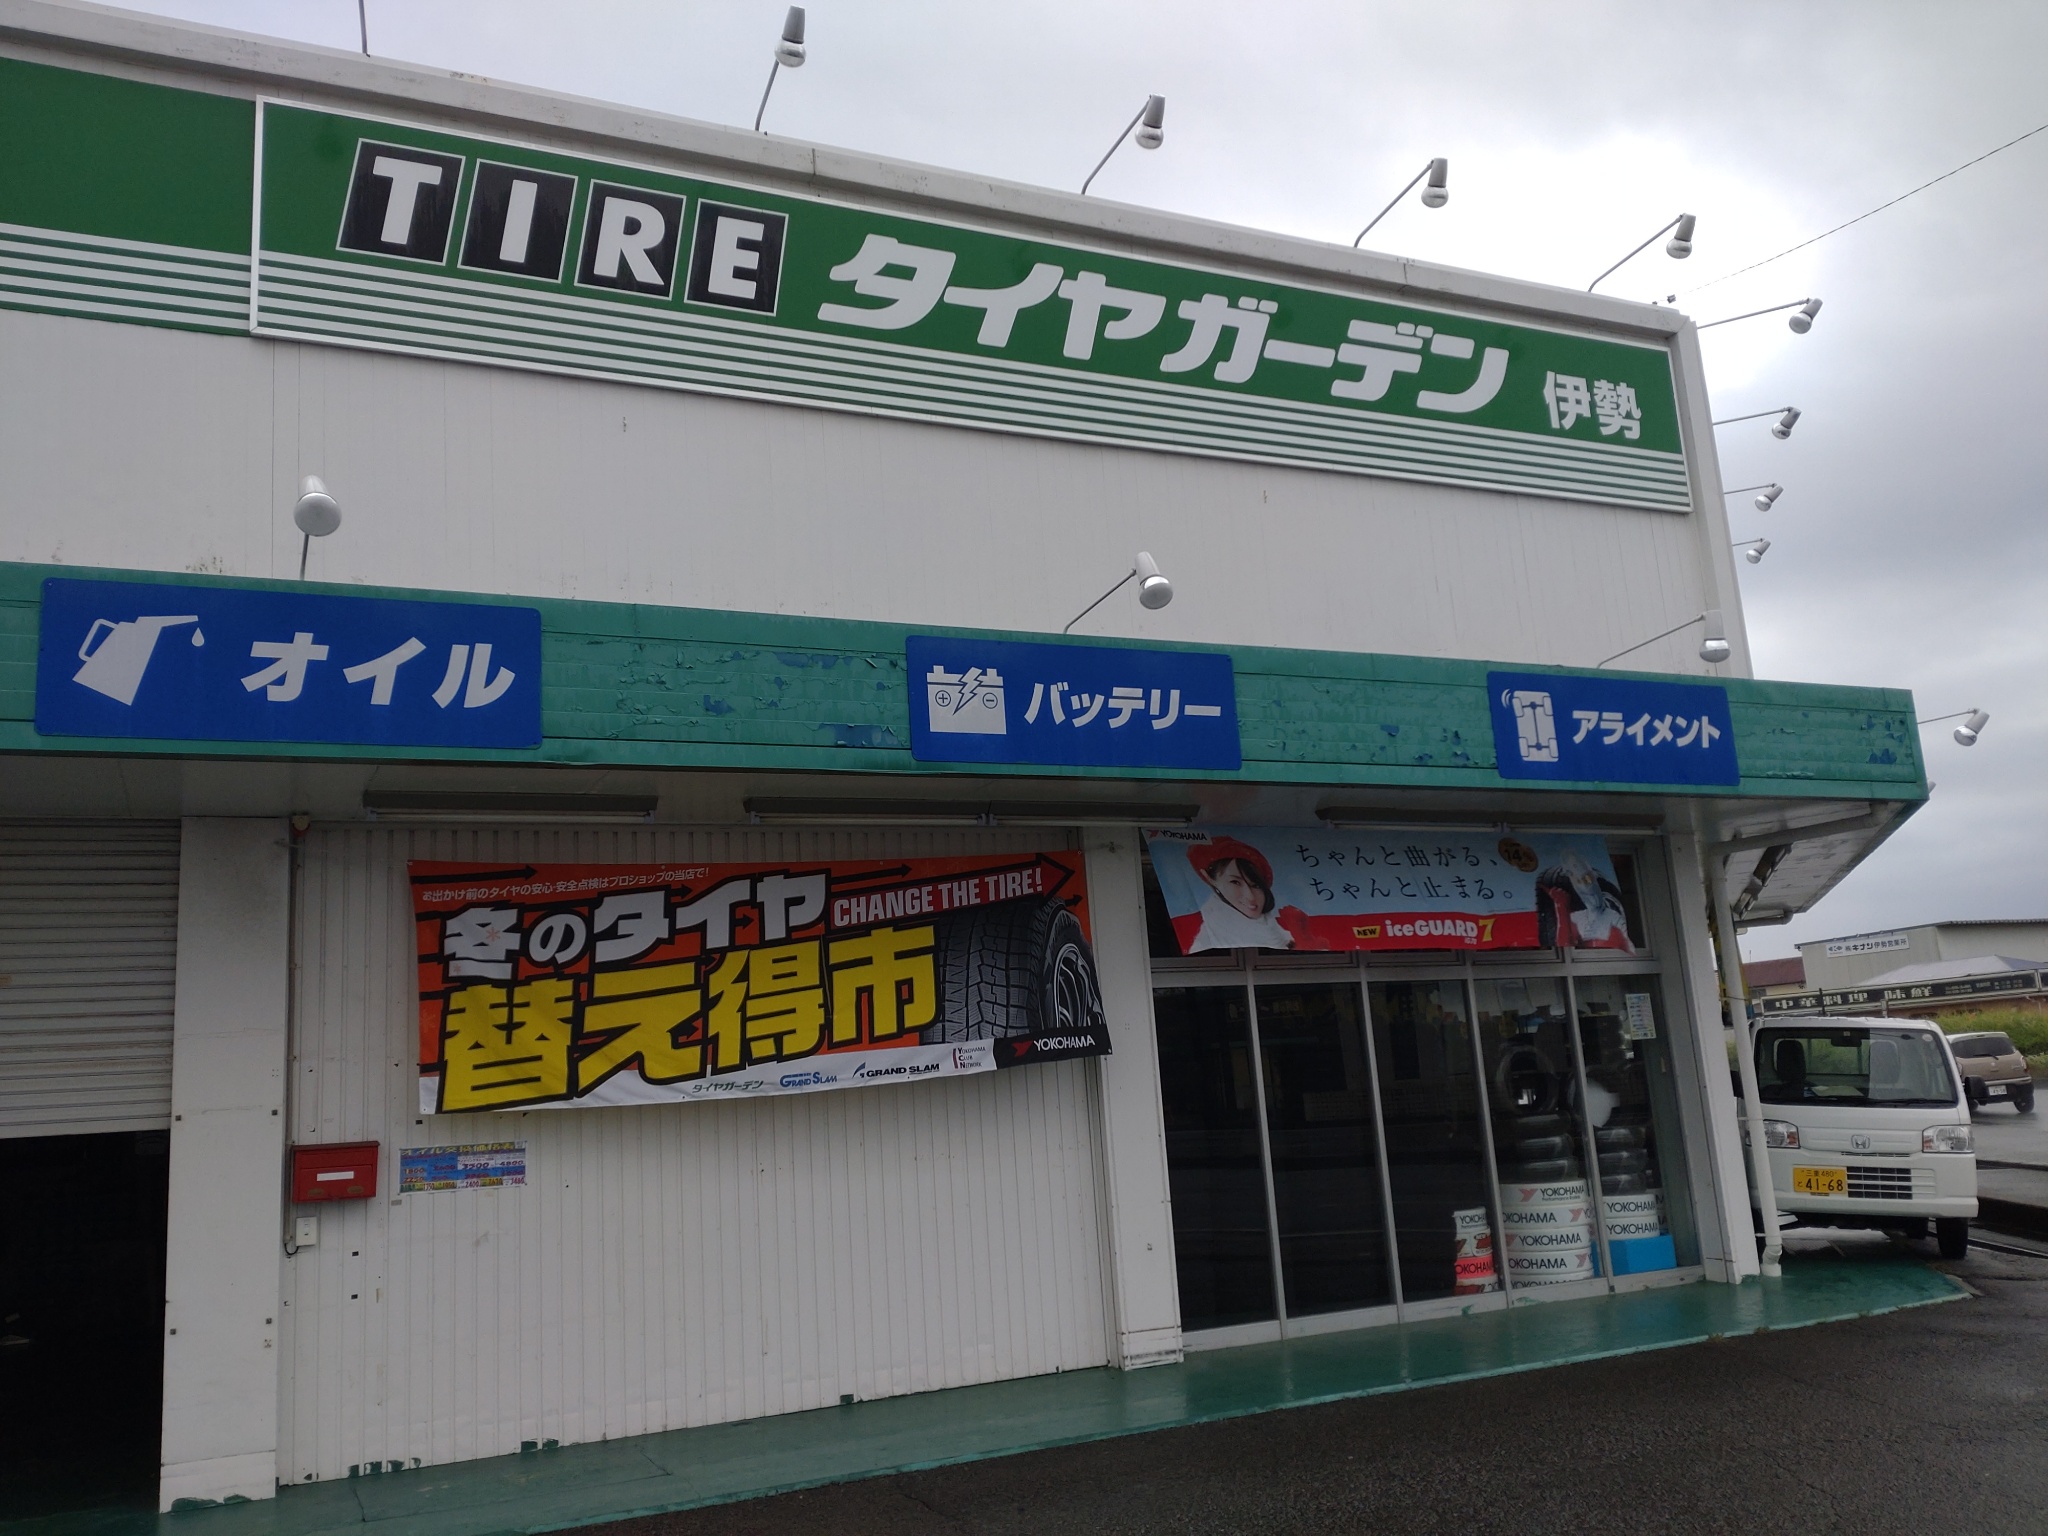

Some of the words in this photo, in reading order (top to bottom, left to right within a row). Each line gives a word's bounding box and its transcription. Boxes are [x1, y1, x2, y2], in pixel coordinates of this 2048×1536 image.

[372, 155, 765, 299] TIRE
[816, 233, 1509, 413] タイヤガーデン
[1542, 370, 1641, 440] 伊勢
[241, 631, 516, 709] オイル
[1025, 681, 1222, 730] バッテリー
[1572, 710, 1721, 749] アライメント
[1296, 844, 1498, 867] ちゃんと曲がる、
[833, 885, 933, 927] CHANGE
[939, 879, 981, 910] THE
[985, 867, 1043, 902] TIRE!
[1309, 876, 1513, 900] ちゃんと止まる。
[444, 873, 827, 980] 冬のタイヤ
[1356, 928, 1378, 936] NEW
[1479, 918, 1496, 942] 7
[441, 927, 935, 1112] 替え得市
[1034, 1035, 1095, 1052] YOKOHAMA
[867, 1067, 906, 1078] GRAND
[908, 1064, 940, 1074] SLAM
[692, 1080, 763, 1093] タイヤガーデン
[1805, 1178, 1844, 1191] 41-68
[1503, 1212, 1557, 1224] OKOHAMA
[1519, 1235, 1583, 1247] YOKOHAMA
[1508, 1258, 1568, 1270] OKOHAMA
